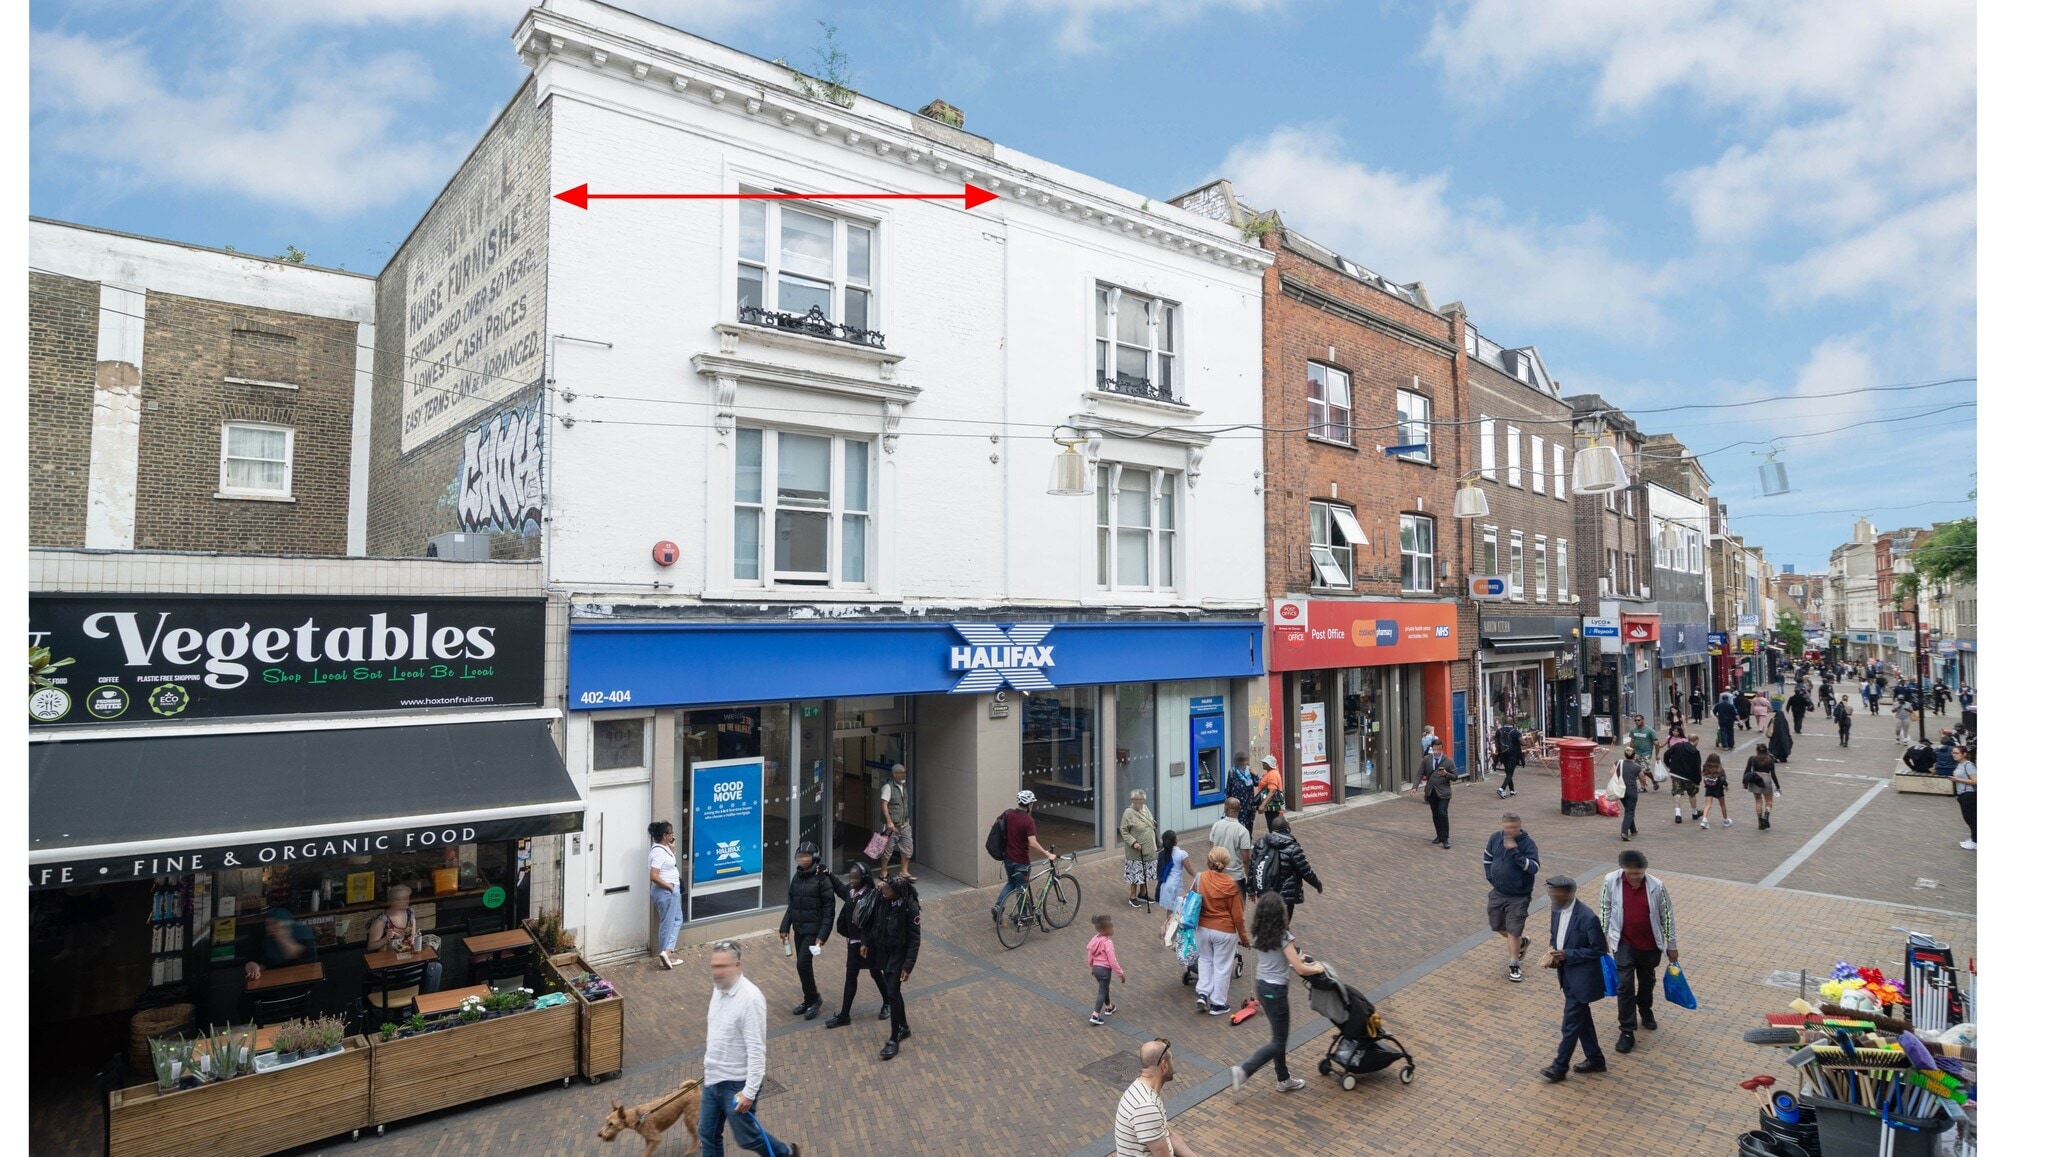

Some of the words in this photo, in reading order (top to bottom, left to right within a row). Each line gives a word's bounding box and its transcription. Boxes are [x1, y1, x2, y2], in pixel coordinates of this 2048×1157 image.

[409, 280, 443, 338] HOUSE
[410, 308, 461, 368] ESTABLISHED
[463, 285, 487, 325] OVER
[489, 271, 504, 304] 50
[413, 351, 452, 397] LOWEST
[454, 327, 483, 367] CASH
[485, 294, 527, 346] PRICES
[405, 404, 424, 435] EASY
[424, 389, 450, 427] TERMS
[451, 373, 472, 407] CAN
[1287, 633, 1305, 641] OFFICE
[1311, 628, 1326, 640] Post
[1327, 628, 1345, 640] Office
[1435, 626, 1449, 637] NHS
[82, 611, 496, 690] Vegetables
[951, 645, 1056, 669] HALIFAX
[52, 677, 68, 685] FOOD
[137, 675, 159, 683] PLASTIC
[174, 674, 201, 682] SHOPPING
[262, 668, 301, 684] Shop
[308, 668, 348, 684] Local
[353, 667, 383, 680] Eat
[388, 666, 425, 681] Local
[429, 664, 455, 679] Be
[459, 664, 494, 679] Local
[400, 695, 494, 707] www.hoxtonfruit.com
[581, 690, 631, 704] 402-404
[713, 781, 744, 793] GOOD
[713, 790, 743, 803] MOVE
[133, 854, 204, 876] FINE
[223, 851, 242, 867] &
[258, 835, 389, 863] ORGANIC
[406, 827, 477, 848] FOOD
[716, 845, 741, 855] HALIFAX
[1255, 860, 1266, 890] adidas
